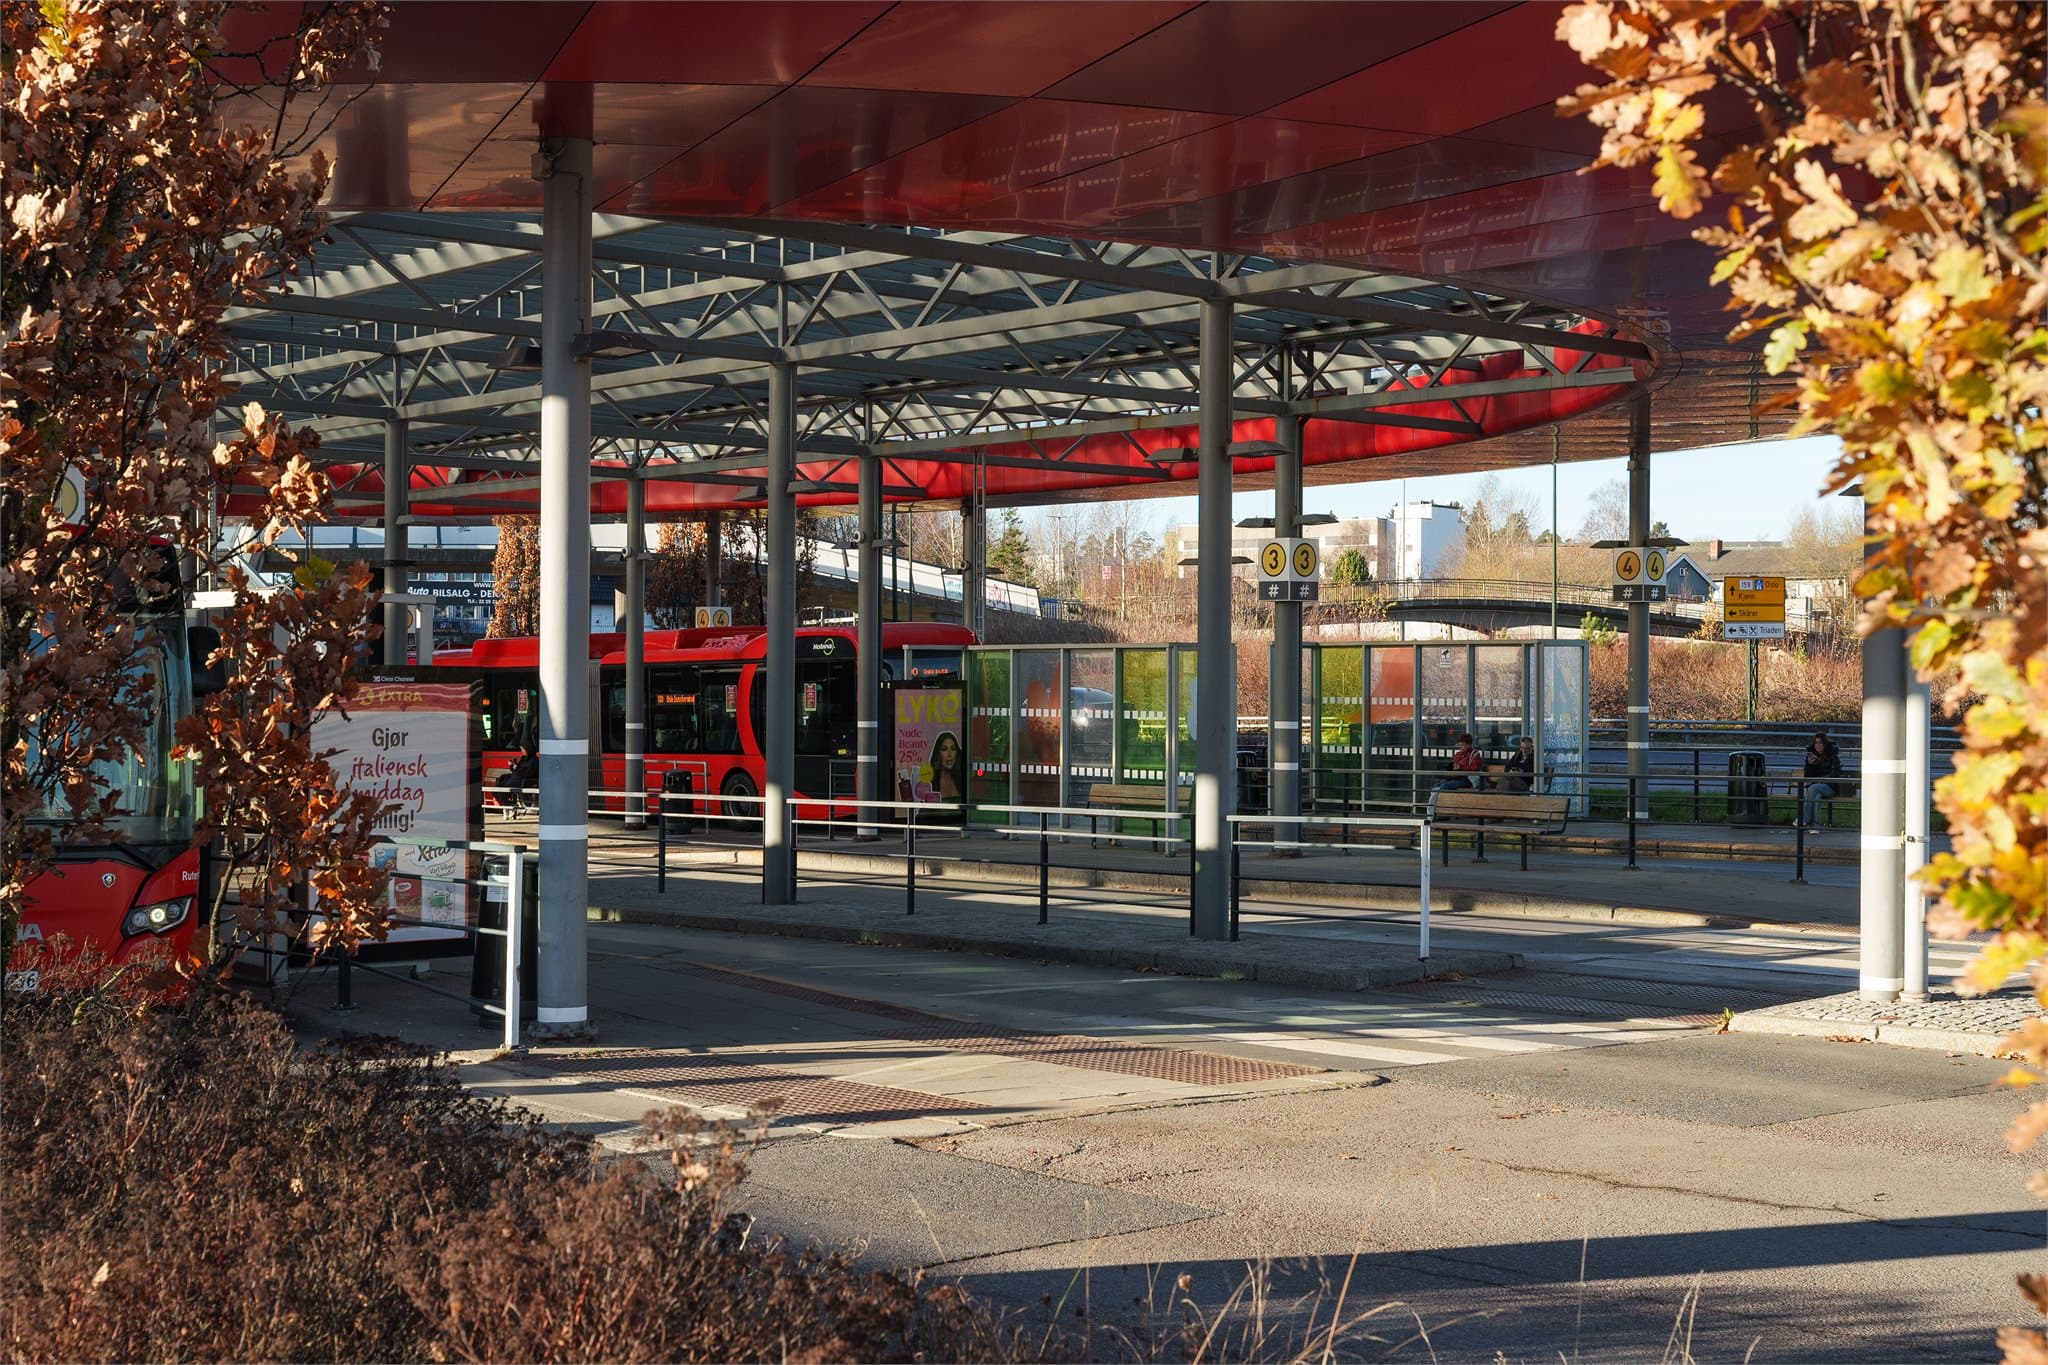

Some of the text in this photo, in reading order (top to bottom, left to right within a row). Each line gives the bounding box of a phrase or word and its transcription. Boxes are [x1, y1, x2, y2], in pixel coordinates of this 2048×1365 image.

[1269, 549, 1309, 570] 3 3
[1622, 556, 1660, 575] 4 4
[1764, 581, 1779, 589] Oslo
[408, 586, 429, 596] Auto
[432, 589, 470, 598] BILSALG
[718, 613, 724, 625] 4
[1760, 626, 1782, 634] Triaden
[897, 694, 960, 724] LYKO
[372, 727, 409, 750] Gjør
[898, 728, 921, 738] Nude
[898, 739, 929, 750] Beauty
[898, 750, 923, 763] 25%
[352, 753, 428, 780] italiensk
